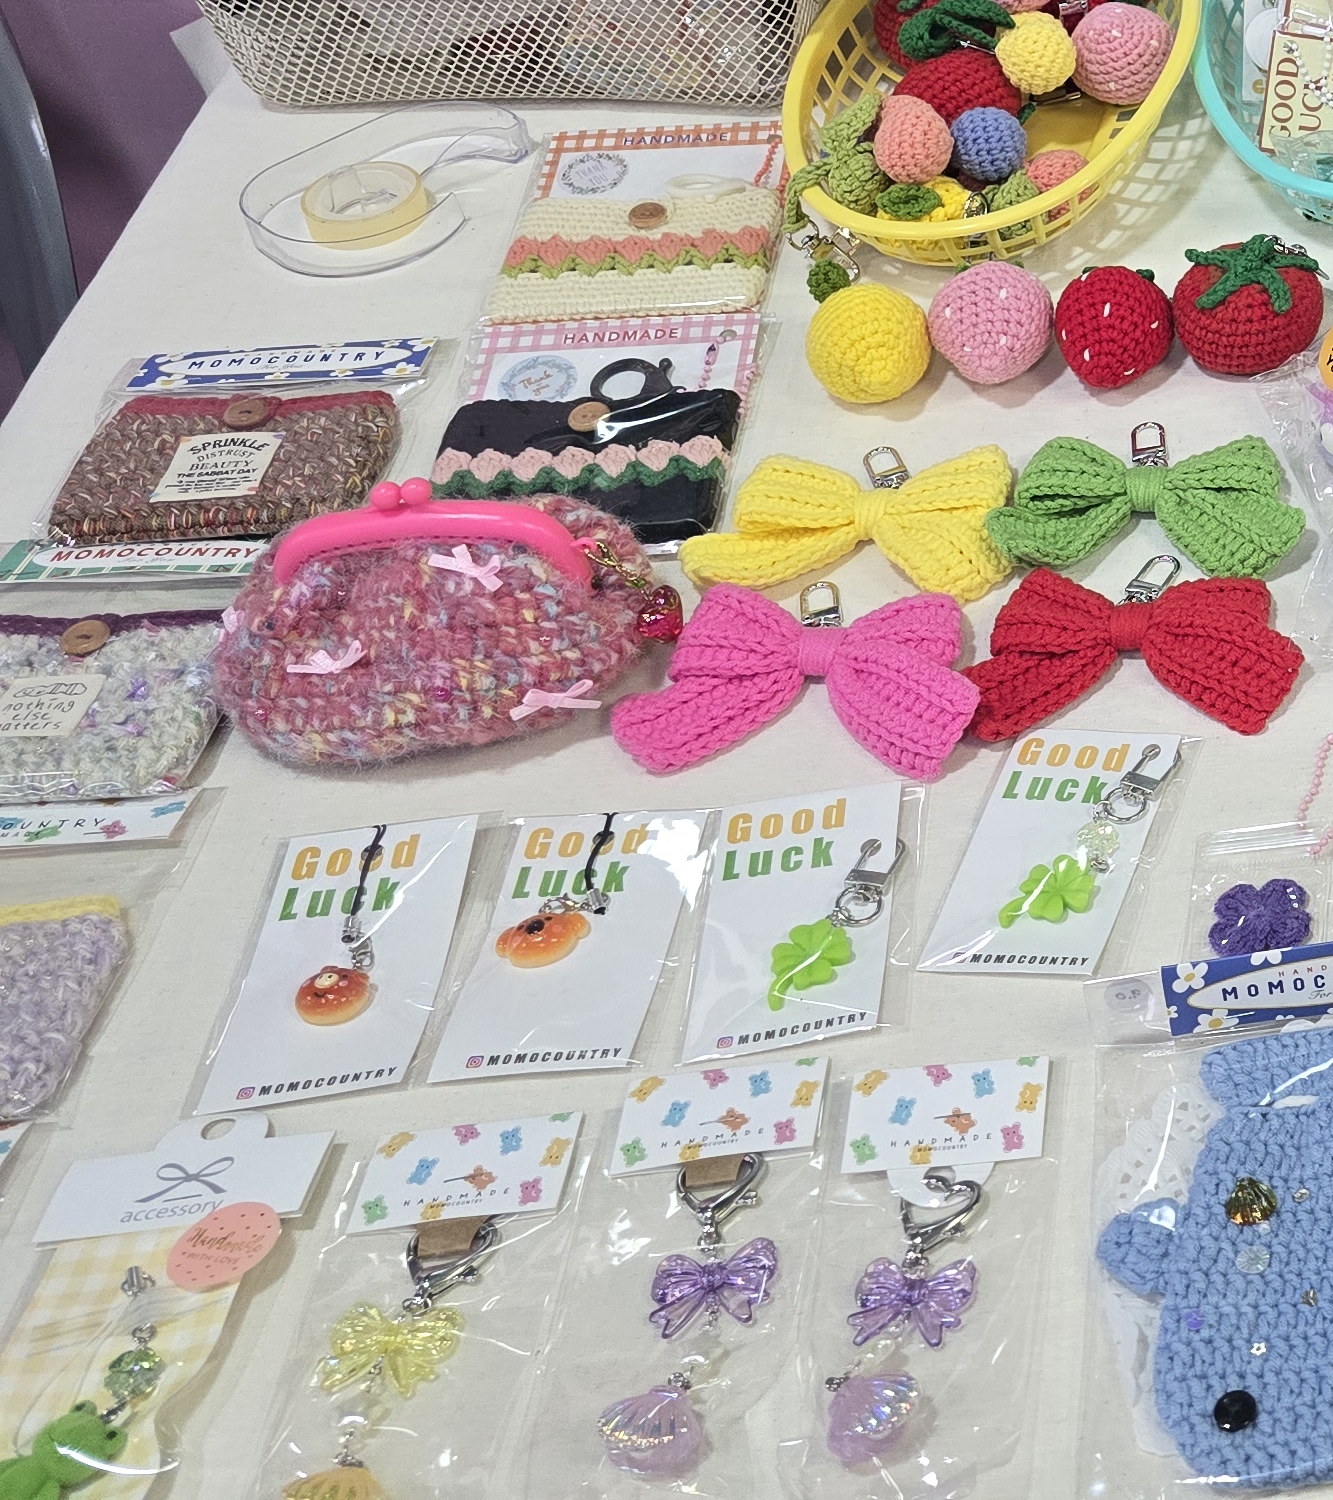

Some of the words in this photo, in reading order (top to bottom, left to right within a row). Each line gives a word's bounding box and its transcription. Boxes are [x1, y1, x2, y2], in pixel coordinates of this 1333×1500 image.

[1269, 55, 1301, 140] GOOD
[623, 132, 729, 146] HANDMADE
[574, 160, 608, 180] THANK
[588, 174, 609, 188] YOU
[563, 328, 680, 345] HANDMADE
[188, 350, 386, 370] MOMOCOUNTRY
[187, 438, 270, 455] SPRINKLE
[197, 449, 256, 463] DISTRUST
[189, 460, 255, 471] BEAUTY
[237, 467, 259, 475] DAY
[50, 546, 260, 562] MOMOCOUNTRY
[0, 719, 63, 732] atters
[12, 710, 51, 722] else
[1016, 737, 1131, 773] Good
[1002, 770, 1109, 805] Luck
[727, 798, 847, 845] Good
[722, 837, 834, 881] Luck
[511, 861, 630, 900] Luck
[279, 877, 401, 922] Luck
[969, 952, 1089, 967] MOMOCOUNTRY
[738, 1011, 869, 1045] MOMOCOUNTRY
[486, 1047, 623, 1067] MOMOCOUNTRY
[259, 1067, 398, 1097] MOMOCOUNTRY
[660, 1127, 765, 1149] HANDMADE
[889, 1132, 994, 1148] HANDMADE
[402, 1187, 511, 1207] HANDMADE
[120, 1199, 224, 1224] accessory
